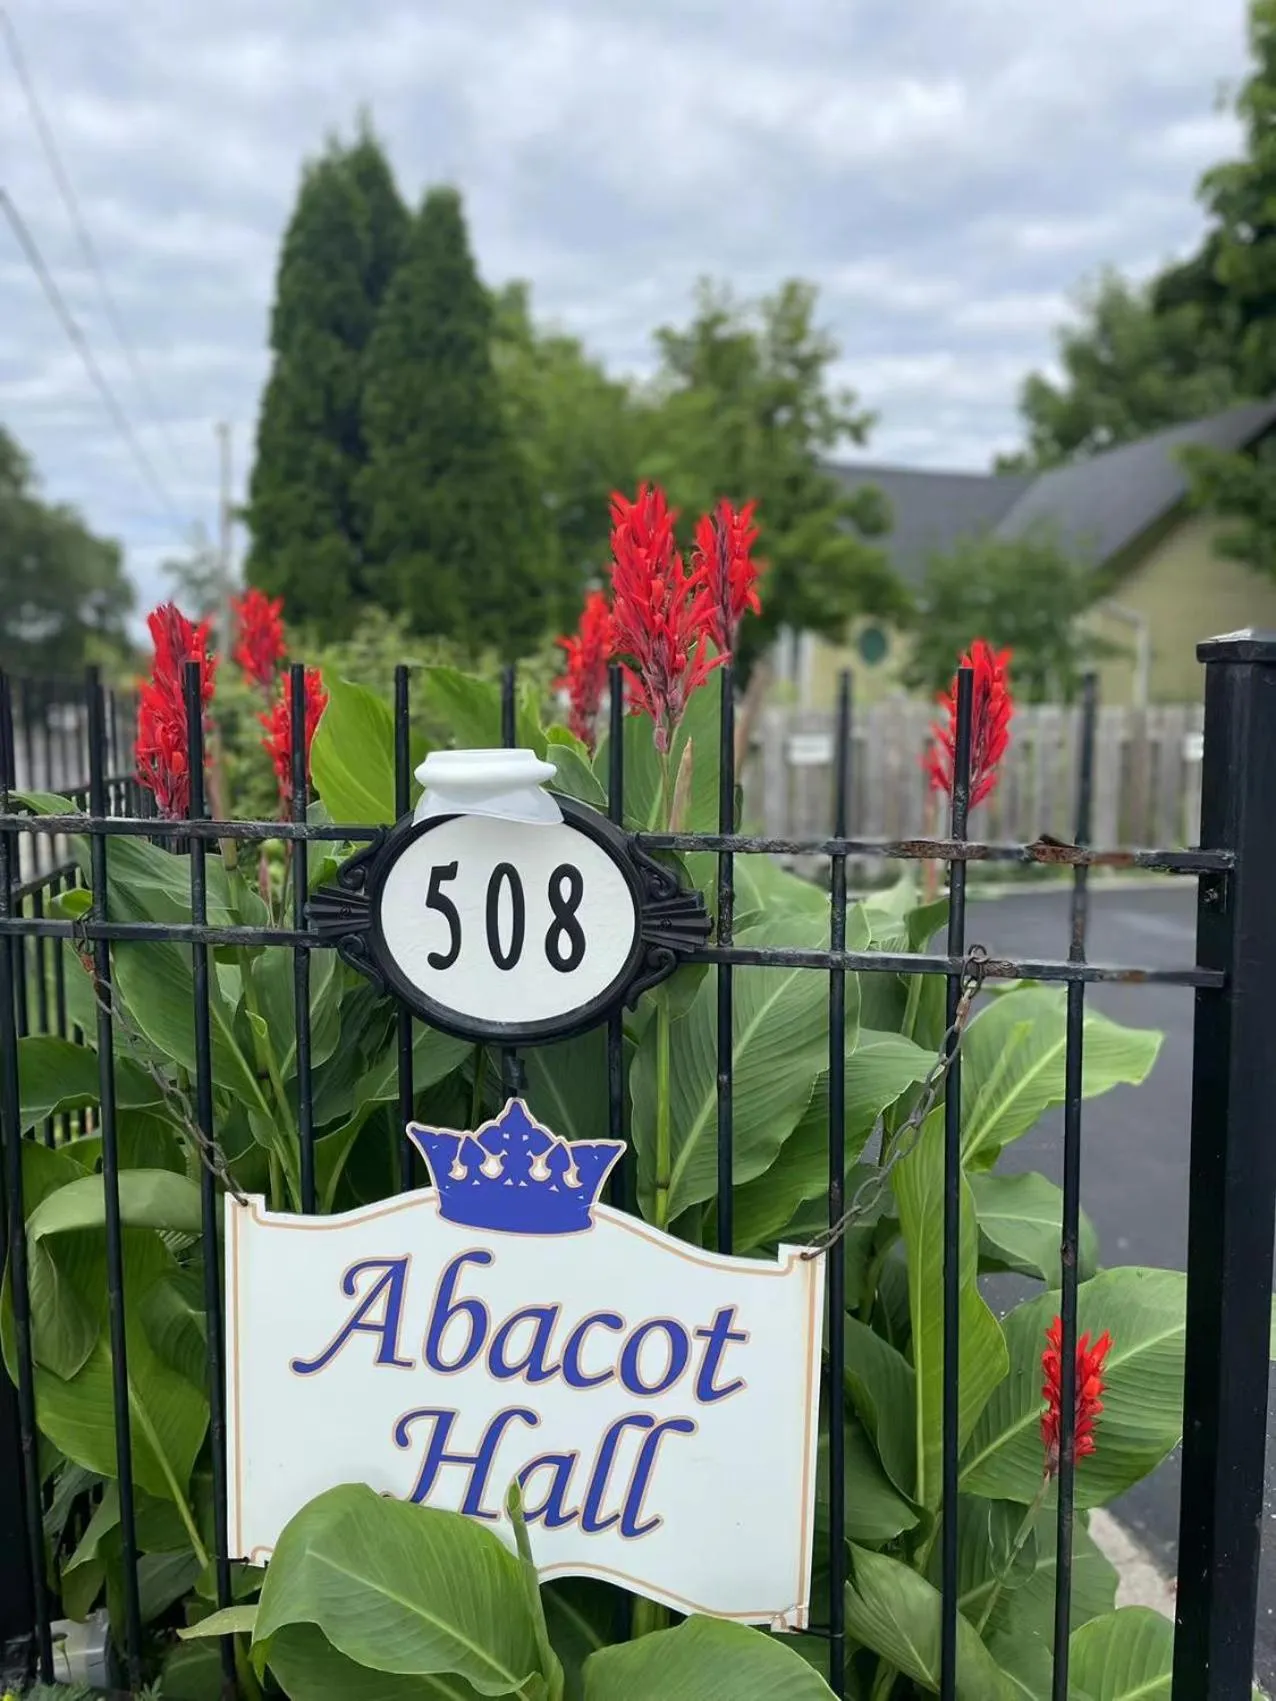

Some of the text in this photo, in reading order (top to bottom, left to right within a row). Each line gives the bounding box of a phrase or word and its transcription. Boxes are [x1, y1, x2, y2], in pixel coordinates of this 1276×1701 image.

[425, 860, 586, 973] 508
[290, 1249, 750, 1404] Abacot
[382, 1407, 698, 1538] Hall
